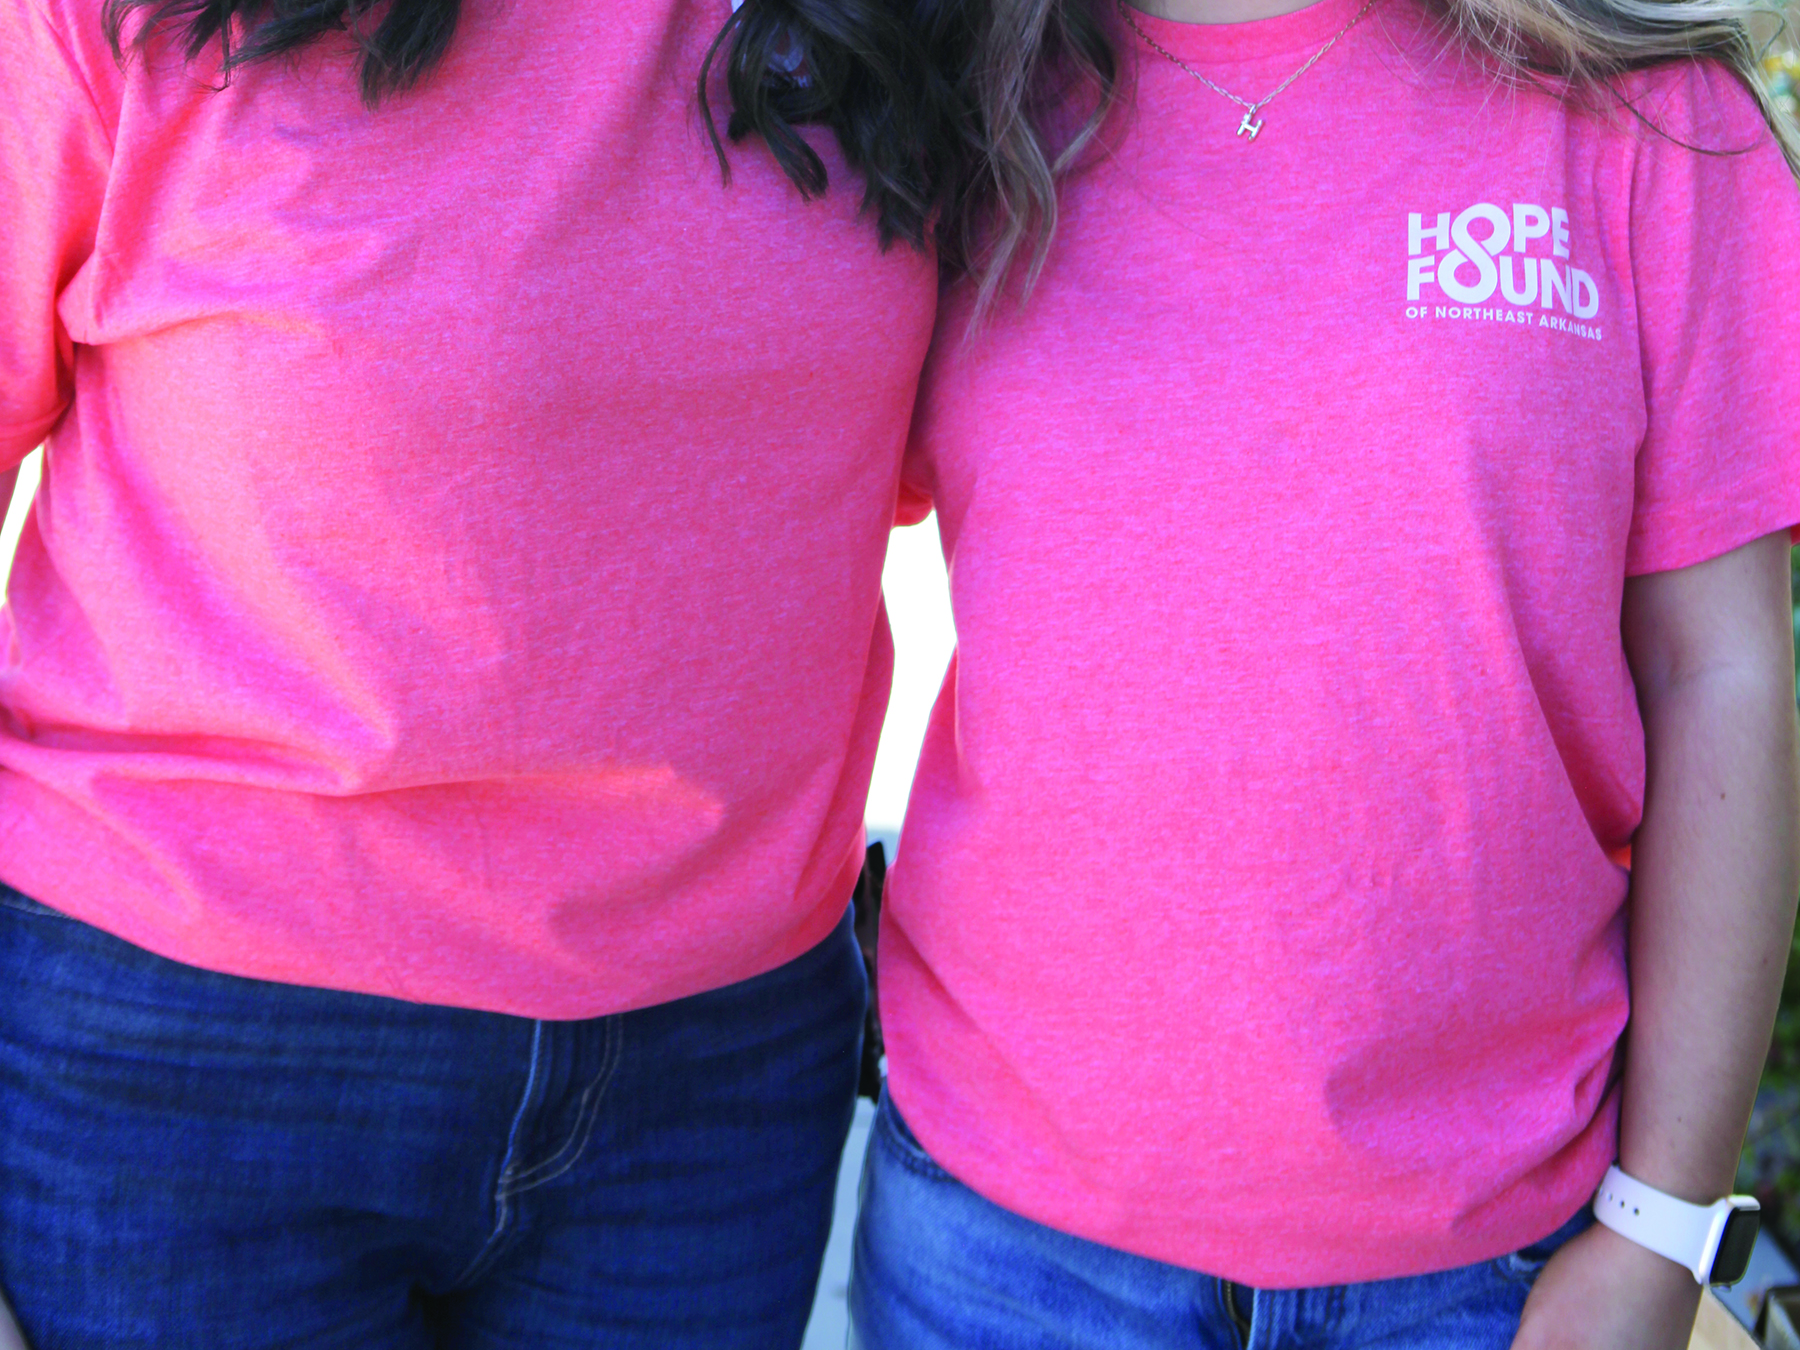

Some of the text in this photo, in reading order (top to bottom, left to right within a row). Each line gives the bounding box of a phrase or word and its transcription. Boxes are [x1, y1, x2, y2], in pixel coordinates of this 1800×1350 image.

[1408, 202, 1570, 260] HOPE
[1407, 249, 1600, 319] FOUND
[1405, 306, 1602, 341] OF NORTHEAST ARKANSAS
